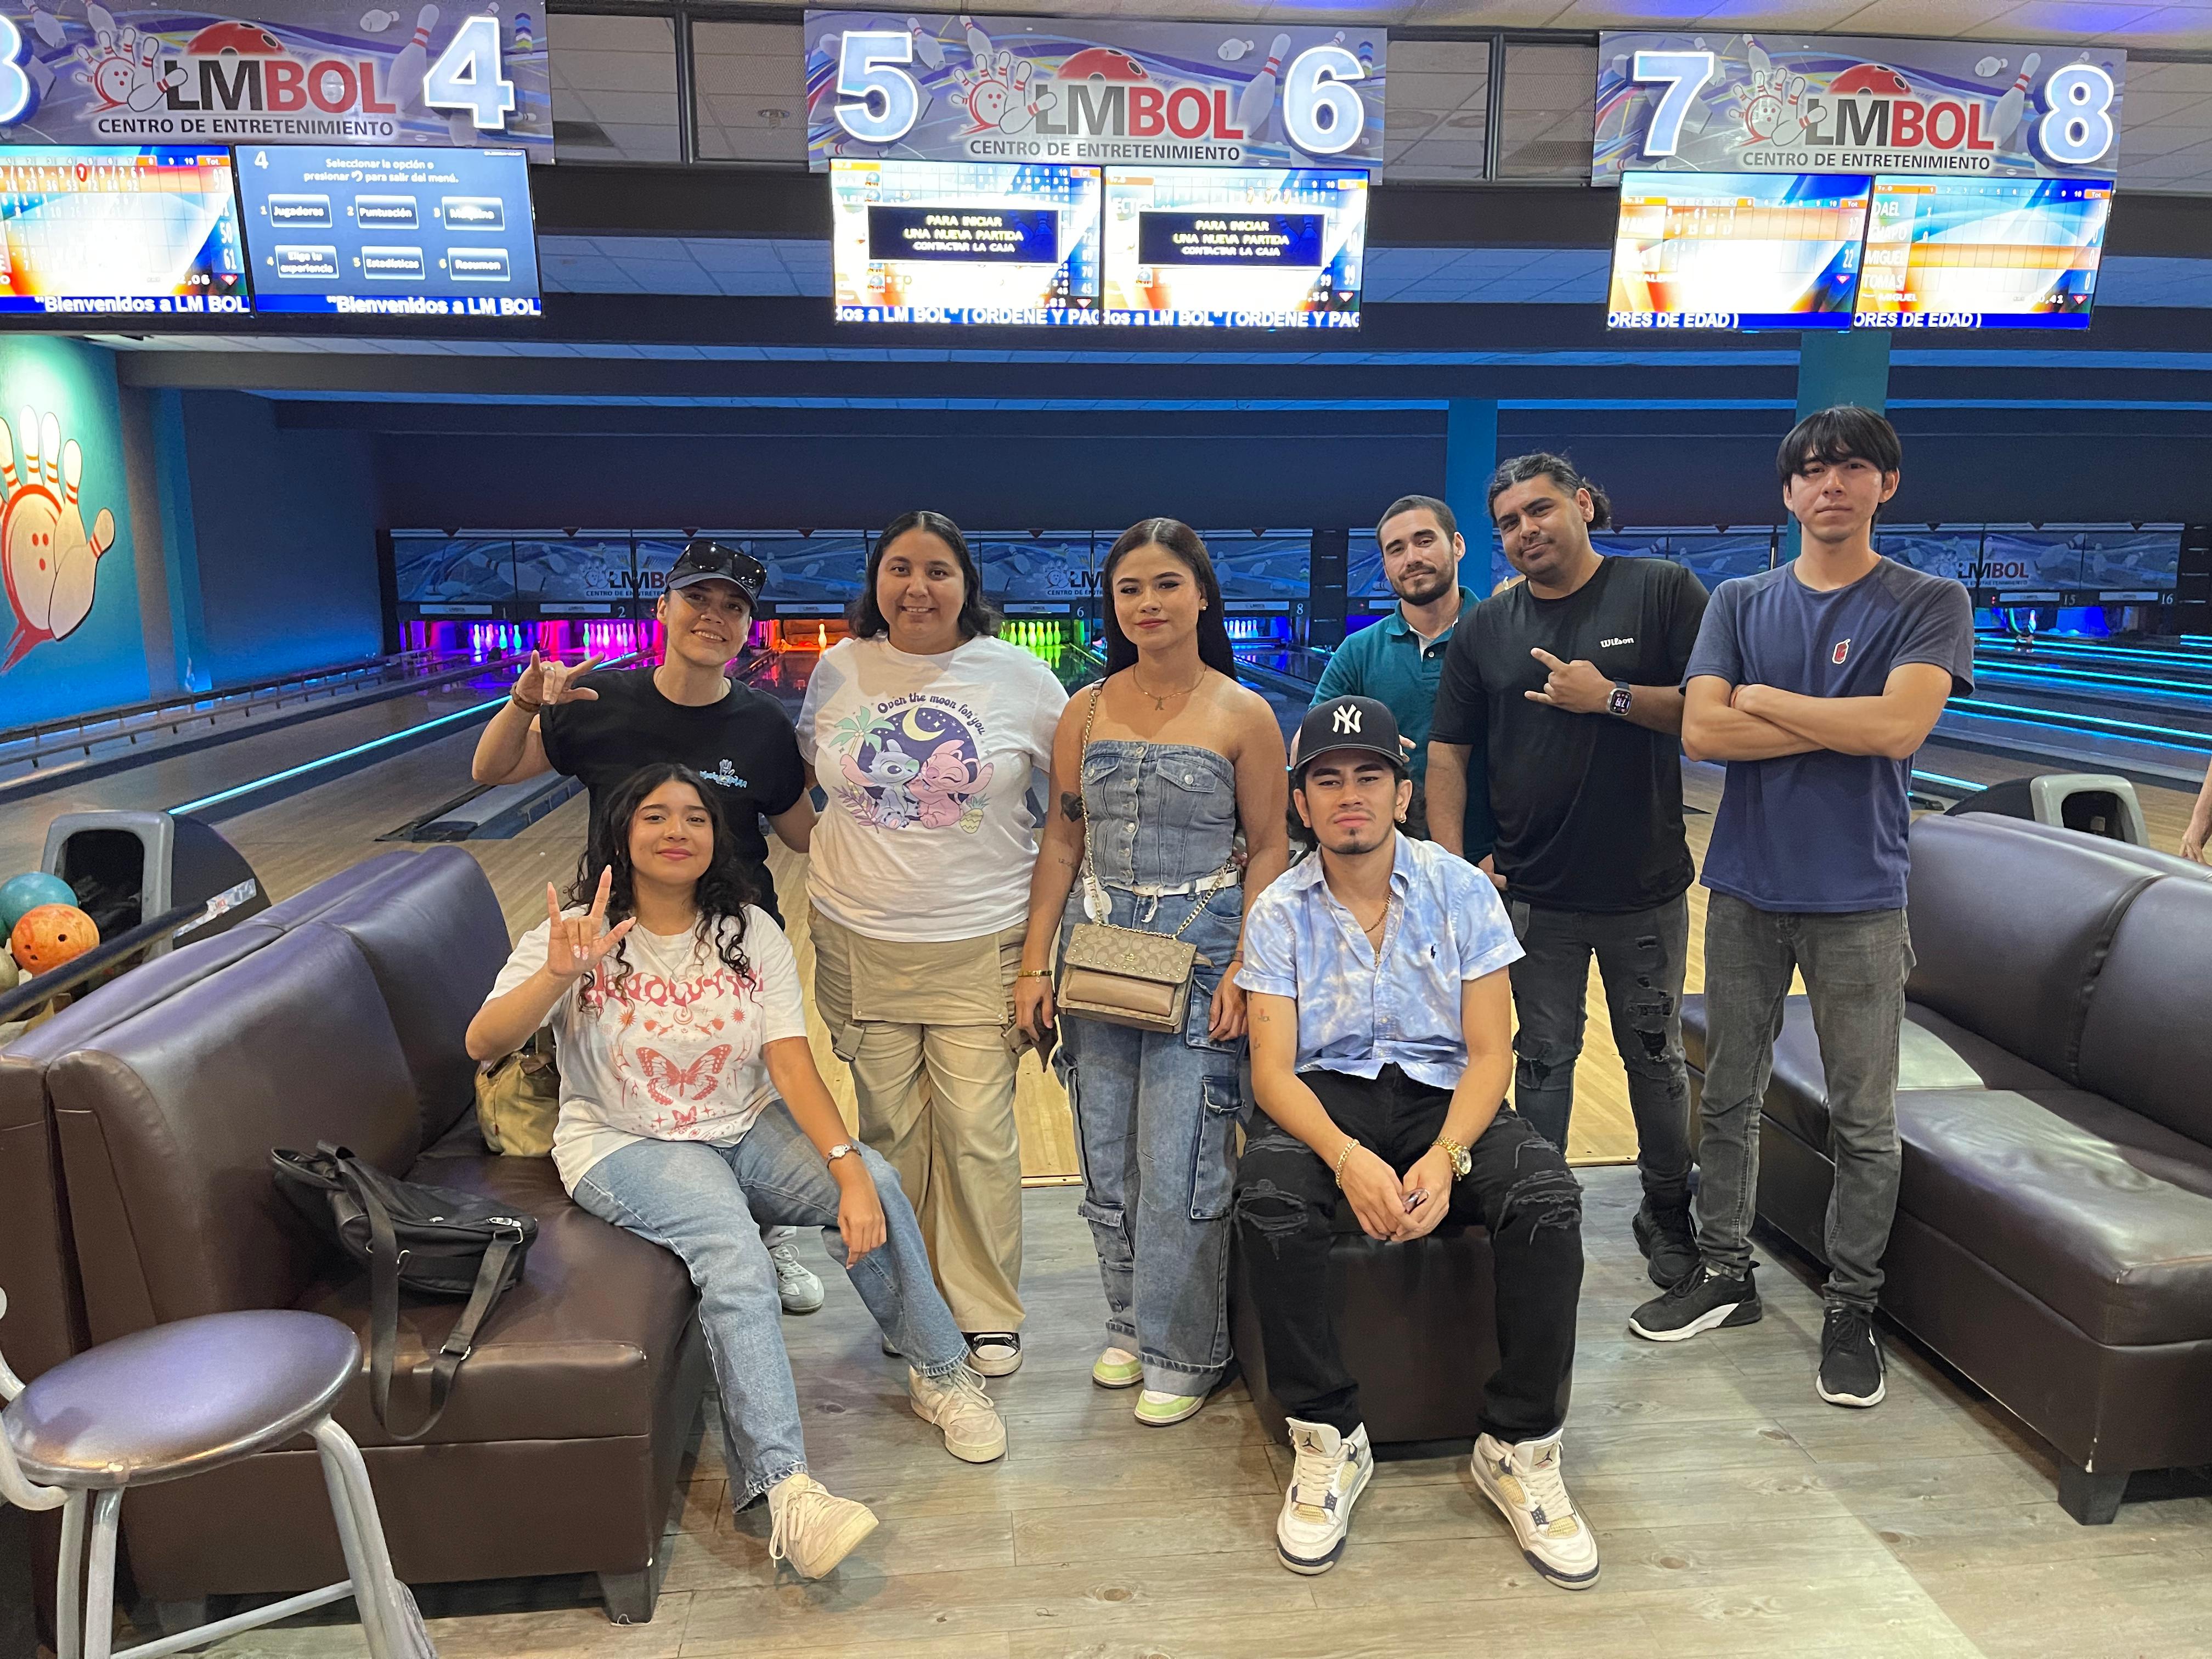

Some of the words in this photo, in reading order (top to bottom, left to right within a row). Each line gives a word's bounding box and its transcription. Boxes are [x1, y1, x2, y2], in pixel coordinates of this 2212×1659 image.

[424, 16, 515, 129] 4
[834, 31, 919, 143] 5
[1283, 46, 1366, 155] 6
[1633, 50, 1714, 157] 7
[2041, 64, 2114, 164] 8
[98, 119, 174, 134] CENTRO
[180, 119, 206, 134] DE
[213, 120, 393, 137] ENTRETENIMIENTO
[970, 140, 1041, 156] CENTRO
[1047, 141, 1070, 157] DE
[1077, 143, 1240, 161] ENTRETENIMIENTO
[255, 151, 269, 169] 4
[326, 159, 381, 168] Seleccionar
[382, 159, 391, 168] la
[393, 160, 426, 171] opción
[1743, 152, 1808, 167] CENTRO
[1814, 153, 1836, 167] DE
[1842, 153, 1990, 170] ENTRETENIMIENTO
[304, 172, 349, 182] presionar
[365, 173, 387, 183] para
[389, 172, 409, 182] salir
[411, 173, 426, 182] del
[274, 206, 324, 218] Jugadores
[347, 206, 354, 216] 2
[359, 208, 413, 218] Puntuación
[926, 215, 958, 226] PARA
[962, 216, 1002, 227] INICIAR
[1195, 220, 1227, 230] PARA
[1230, 221, 1269, 232] INICIAR
[904, 228, 931, 239] UNA
[934, 229, 973, 240] NUEVA
[975, 230, 1024, 241] PARTIDA
[1172, 233, 1199, 244] UNA
[1202, 234, 1239, 245] NUEVA
[1243, 235, 1289, 246] PARTIDA
[913, 241, 970, 251] CONTACTAR
[973, 242, 987, 252] LA
[989, 243, 1015, 252] CAJA
[1181, 246, 1237, 256] CONTACTAR
[1239, 247, 1253, 256] LA
[1255, 247, 1281, 257] CAJA
[267, 256, 274, 266] 4
[353, 257, 360, 267] 5
[1842, 249, 1854, 268] 22
[1865, 250, 1905, 264] MIGUEL
[366, 259, 420, 269] Estadísticas
[455, 259, 501, 270] Resumen
[1863, 274, 1904, 289] TOMAS
[160, 299, 171, 312] a
[176, 297, 204, 313] LM
[208, 297, 250, 313] BOL
[453, 301, 465, 313] a
[468, 298, 496, 314] LM
[500, 298, 541, 315] BOL
[868, 309, 879, 321] a
[883, 307, 908, 322] LM
[973, 308, 1048, 324] ORDENE
[1051, 308, 1064, 324] Y
[1134, 313, 1145, 325] a
[1149, 310, 1174, 326] LM
[1235, 312, 1309, 327] ORDENE
[1313, 312, 1326, 327] Y
[1607, 312, 1653, 328] ORES
[1656, 312, 1680, 328] DE
[1683, 313, 1730, 328] EDAD
[1854, 313, 1898, 328] ORES
[1901, 313, 1925, 327] DE
[1928, 313, 1973, 328] EDAD
[2064, 594, 2076, 605] 15
[2161, 593, 2174, 605] 16
[618, 606, 627, 618] 2
[1077, 606, 1084, 618] 6
[1296, 603, 1304, 614] 8
[1600, 637, 1634, 648] Wilson
[909, 692, 926, 702] the
[930, 695, 956, 709] moon
[967, 717, 985, 735] you
[1333, 704, 1362, 734] NY
